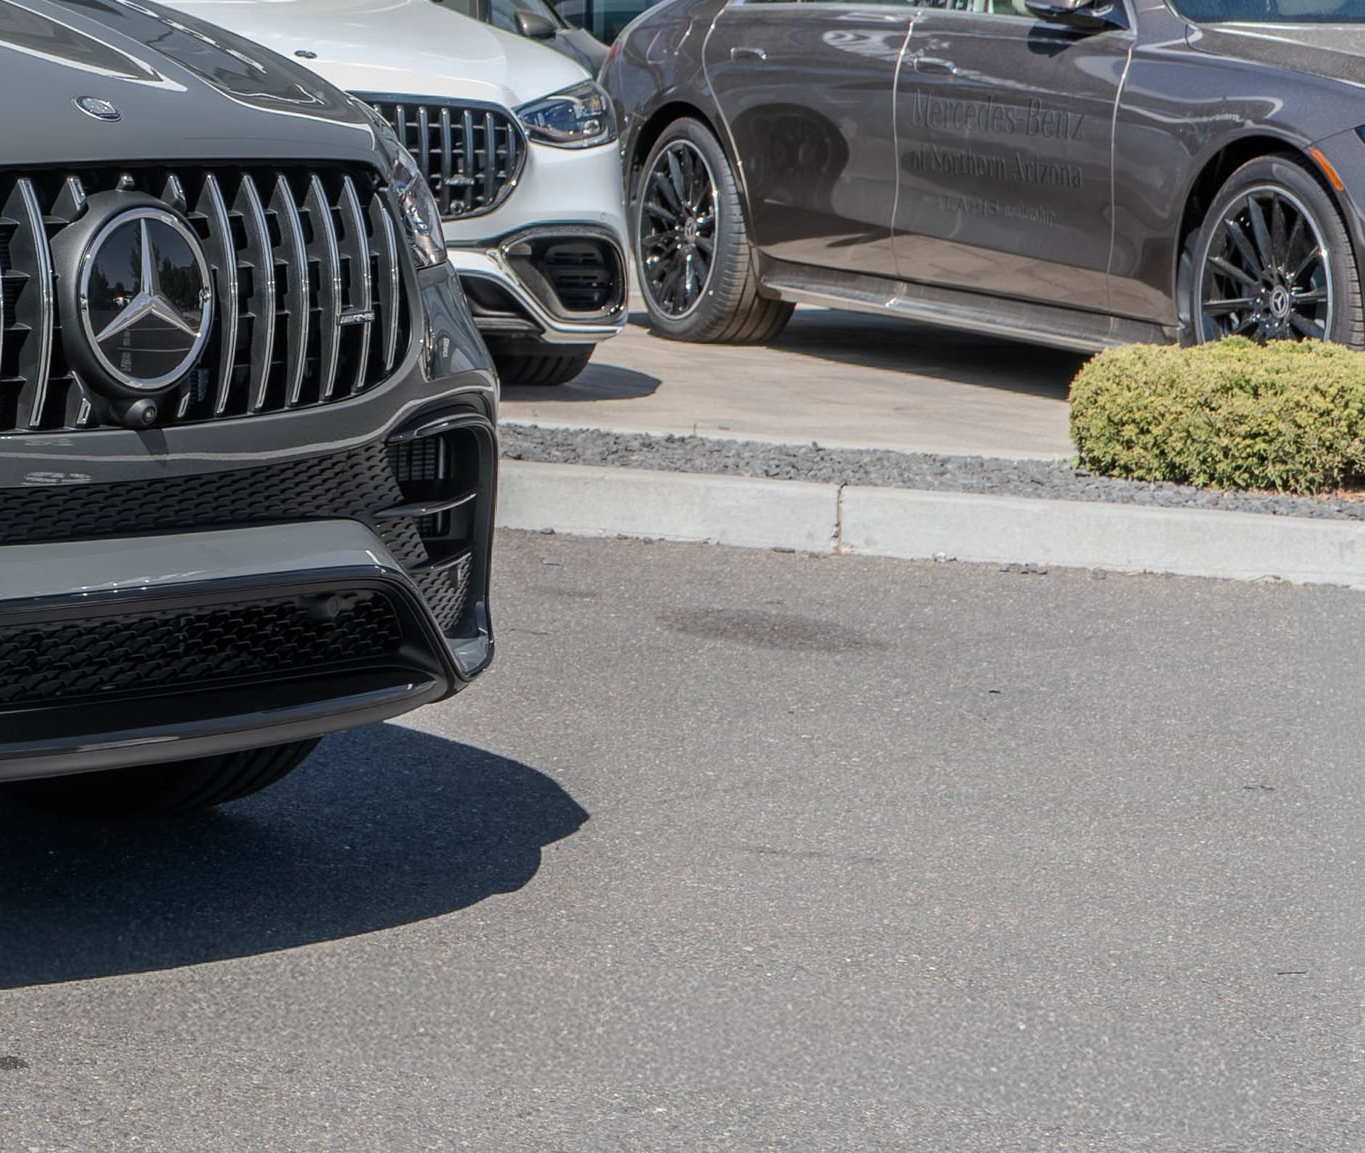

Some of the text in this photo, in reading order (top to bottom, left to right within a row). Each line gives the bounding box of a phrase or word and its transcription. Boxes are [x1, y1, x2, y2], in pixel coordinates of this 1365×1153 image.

[910, 89, 1085, 141] Mercedes-Benz
[930, 146, 1008, 179] Northern
[1011, 152, 1084, 189] Arizona
